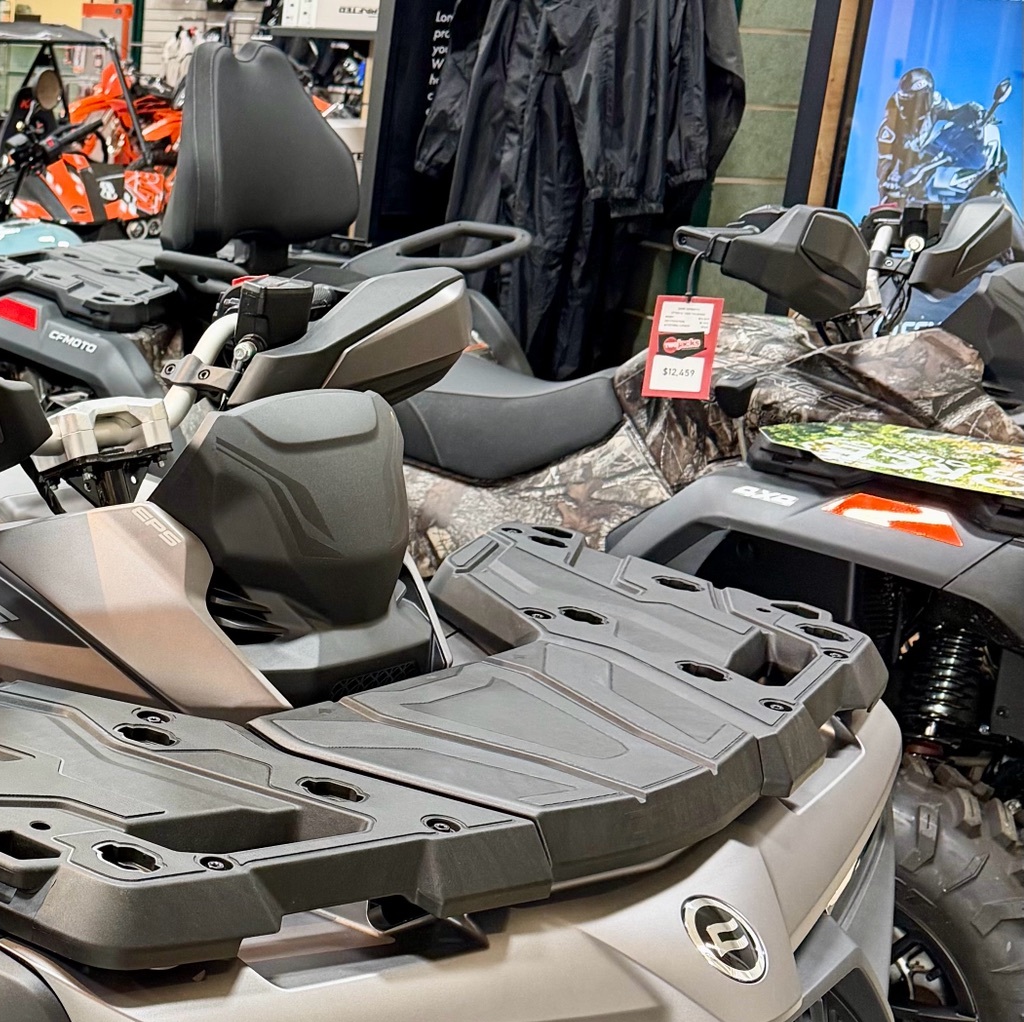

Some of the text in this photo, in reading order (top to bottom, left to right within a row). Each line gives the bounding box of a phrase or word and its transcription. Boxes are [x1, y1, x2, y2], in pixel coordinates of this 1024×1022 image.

[435, 11, 453, 23] Lon
[48, 329, 98, 354] CFMOTO
[662, 367, 696, 377] $12,459
[131, 506, 182, 547] EPS
